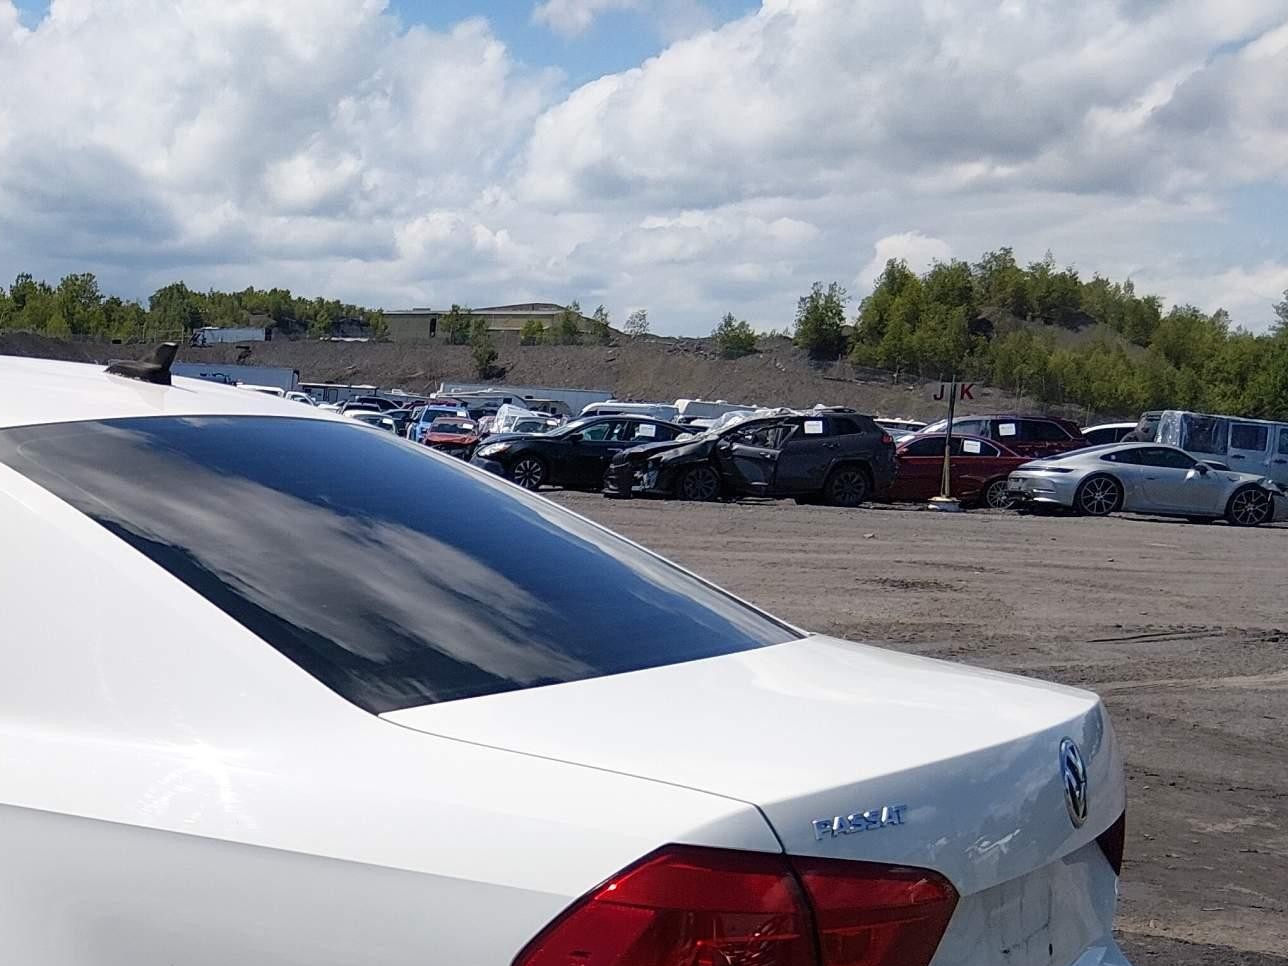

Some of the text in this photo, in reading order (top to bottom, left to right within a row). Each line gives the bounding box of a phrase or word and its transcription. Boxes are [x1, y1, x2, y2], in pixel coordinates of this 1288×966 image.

[933, 384, 945, 401] J
[960, 384, 974, 400] K
[811, 804, 907, 841] PASSAT
